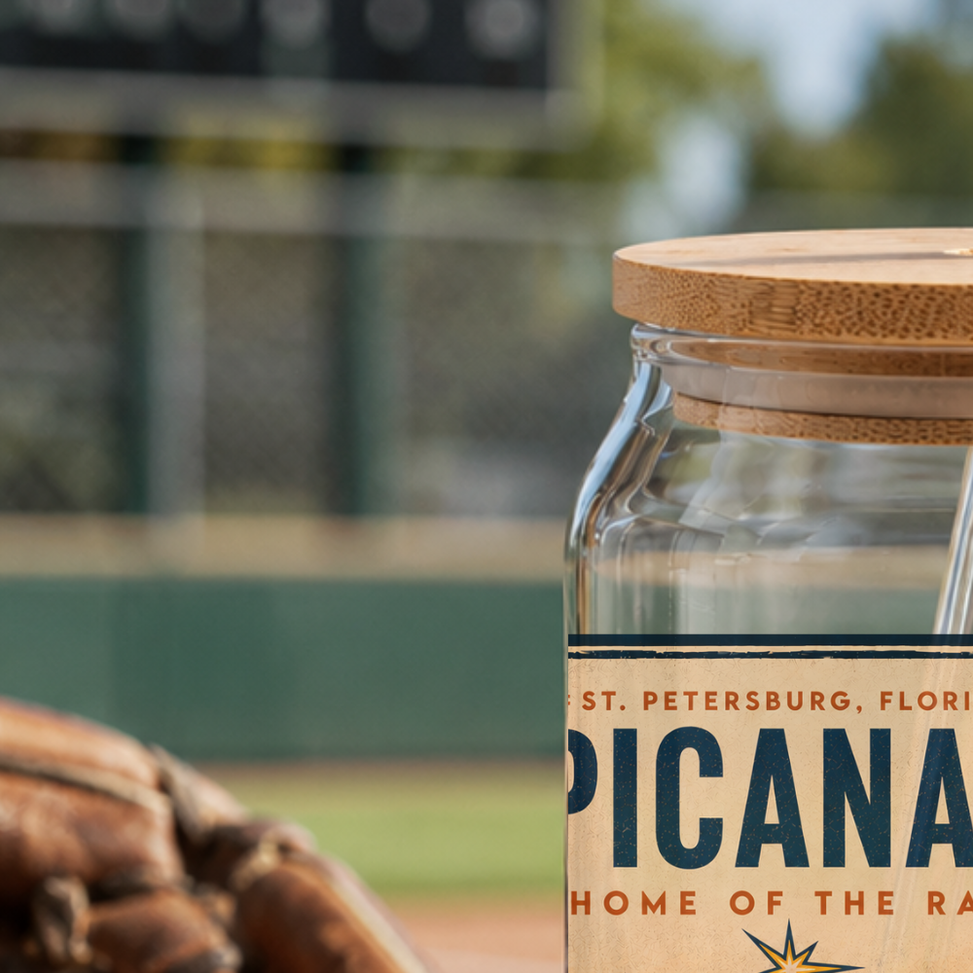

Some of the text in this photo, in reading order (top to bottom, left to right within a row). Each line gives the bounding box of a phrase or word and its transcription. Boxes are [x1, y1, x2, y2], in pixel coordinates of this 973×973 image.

[581, 690, 626, 711] ST.
[643, 690, 862, 714] PETERSBURG,
[570, 890, 697, 916] HOME
[729, 890, 784, 916] OF
[814, 890, 894, 916] THE
